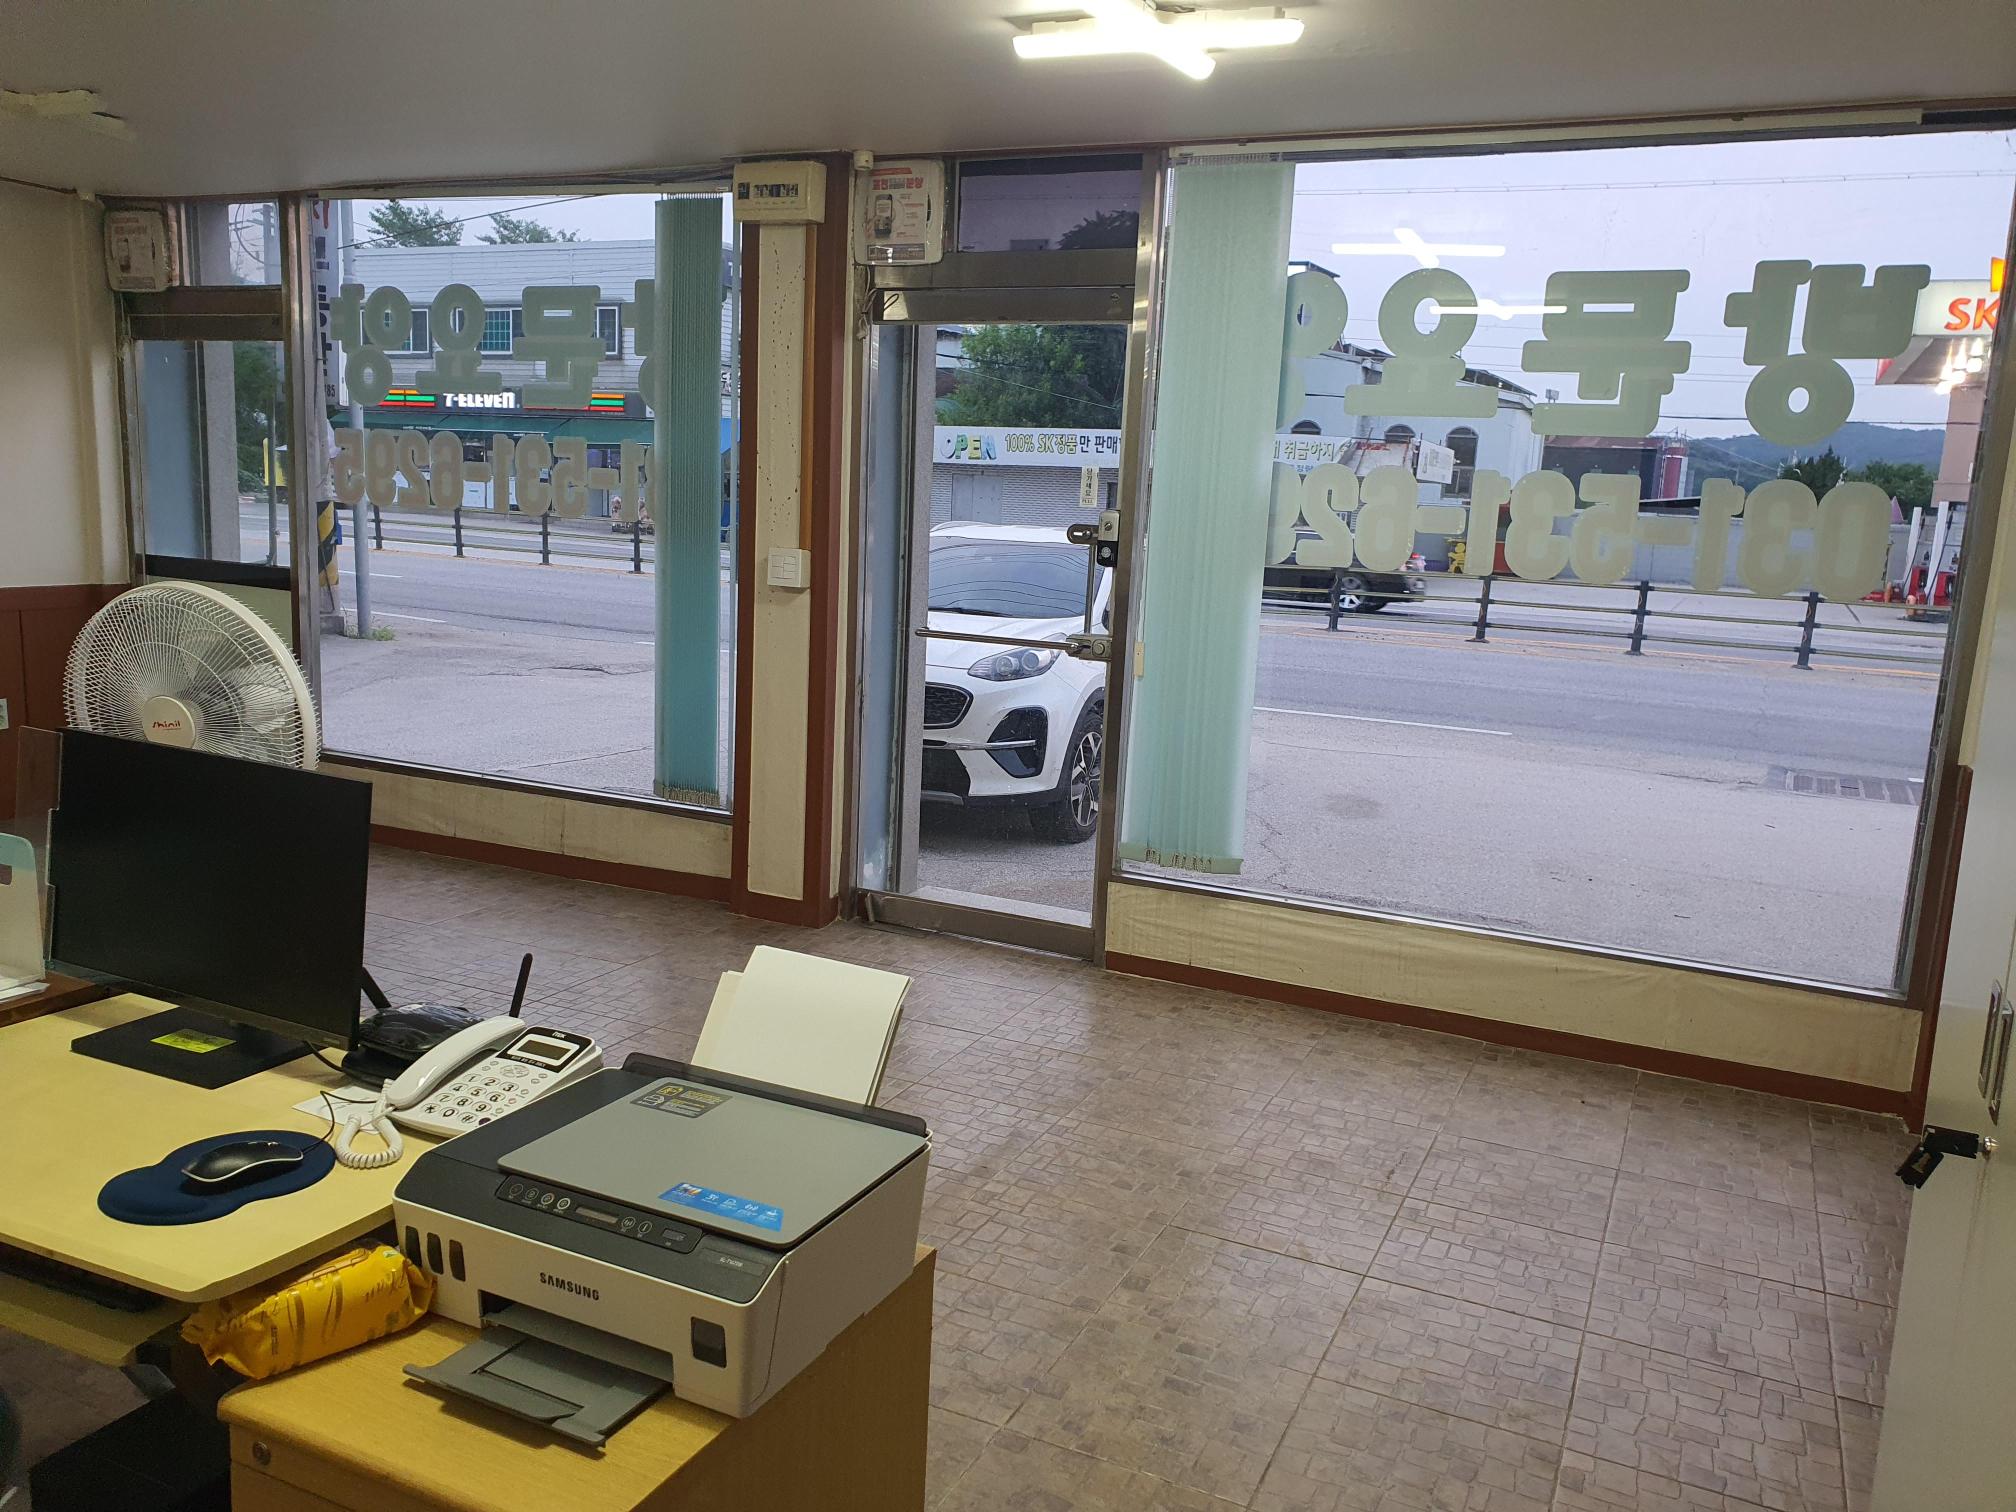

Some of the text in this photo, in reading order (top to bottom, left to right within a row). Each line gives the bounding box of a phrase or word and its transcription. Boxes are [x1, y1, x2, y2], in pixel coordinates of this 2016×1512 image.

[1944, 297, 2001, 331] SK
[941, 434, 997, 460] OPEN
[1004, 433, 1034, 453] 100%
[539, 1272, 600, 1301] SAMSUNG
